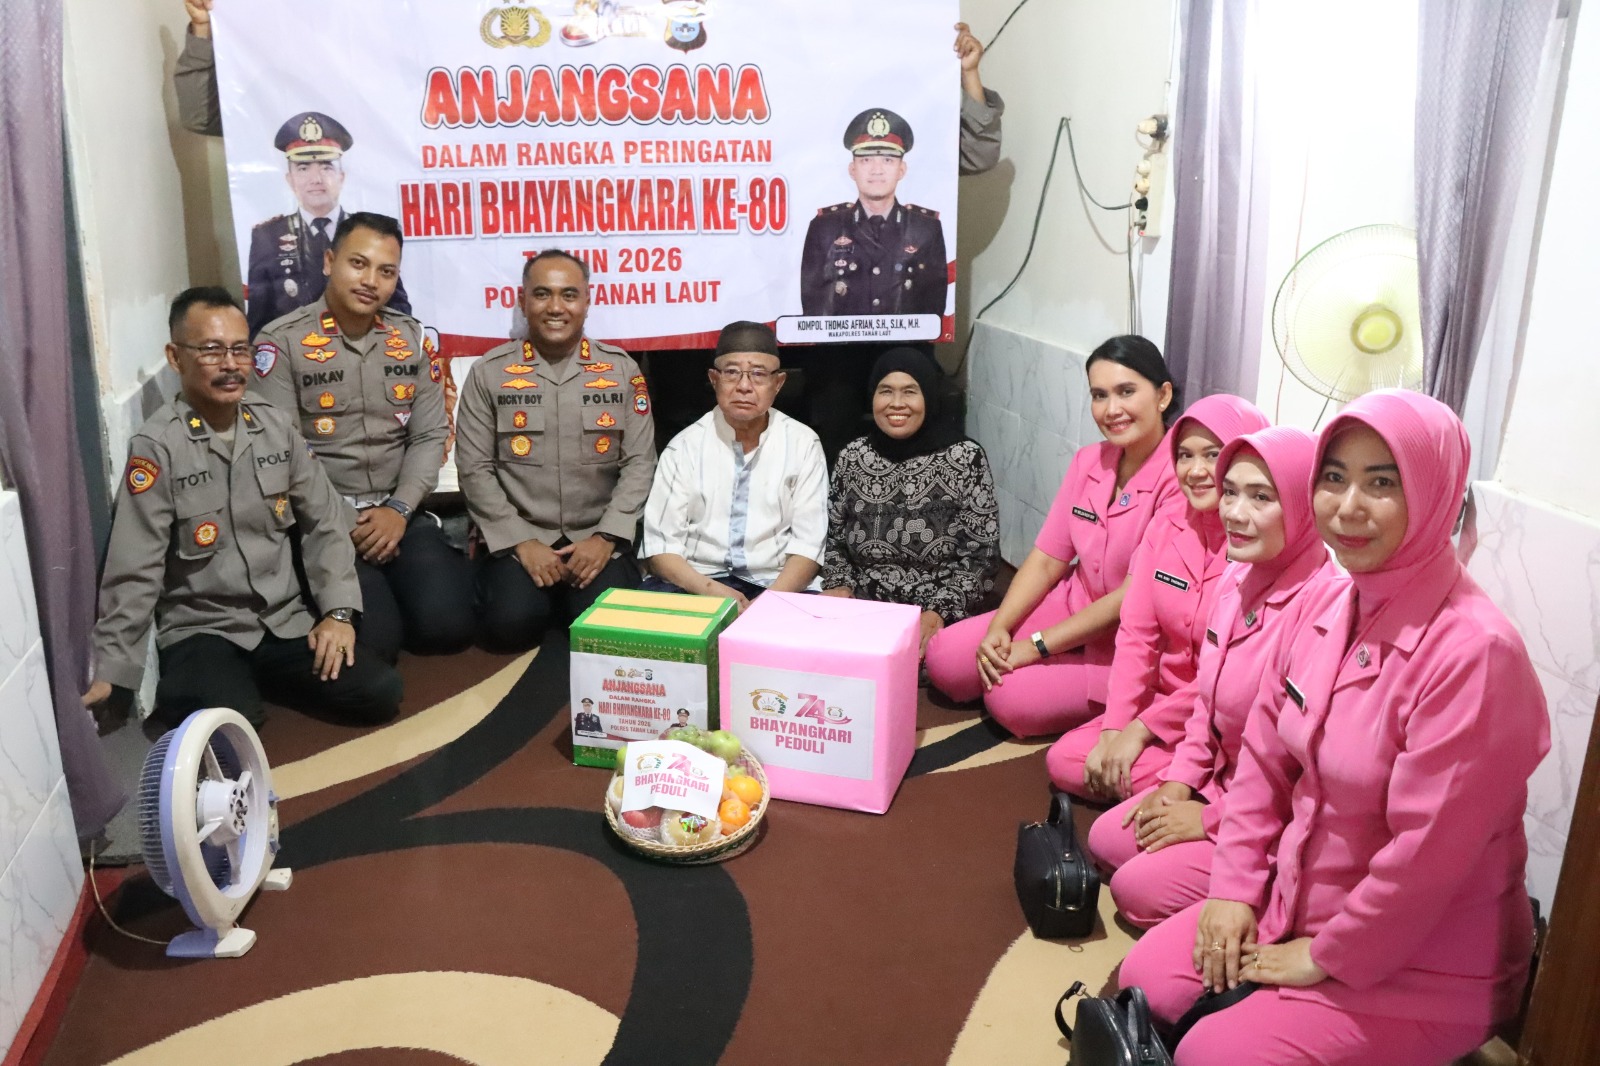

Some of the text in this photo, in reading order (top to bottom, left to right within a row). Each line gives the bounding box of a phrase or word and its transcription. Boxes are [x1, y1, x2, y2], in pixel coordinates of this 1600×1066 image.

[422, 65, 769, 127] ANJANGSANA
[422, 139, 772, 169] DALAM RANGKA PERINGATAN
[400, 176, 788, 237] HARI BHAYANGKARA KE-80
[618, 247, 683, 273] 2026
[665, 280, 721, 304] LAUT
[797, 318, 921, 331] KOMPOL THOMAS AFRIAN, S.H., S.I.K., M.H.
[828, 330, 861, 338] WAKAPOLRES
[302, 369, 345, 387] DIKAV
[497, 394, 543, 406] RICKY BOY
[582, 392, 624, 405] POLRI
[602, 678, 667, 697] ANJANGSANA
[608, 694, 656, 705] DALAM RANGKA
[795, 692, 826, 725] 74
[598, 701, 671, 721] HARI BHAYANGKARA KE-80
[610, 724, 629, 732] POLRES
[618, 717, 651, 727] TAHUN 2026
[750, 716, 852, 743] BHAYANGKARI
[775, 734, 825, 754] PEDULI
[635, 772, 709, 793] BHAYANGKARI
[650, 784, 688, 798] PEDULI
